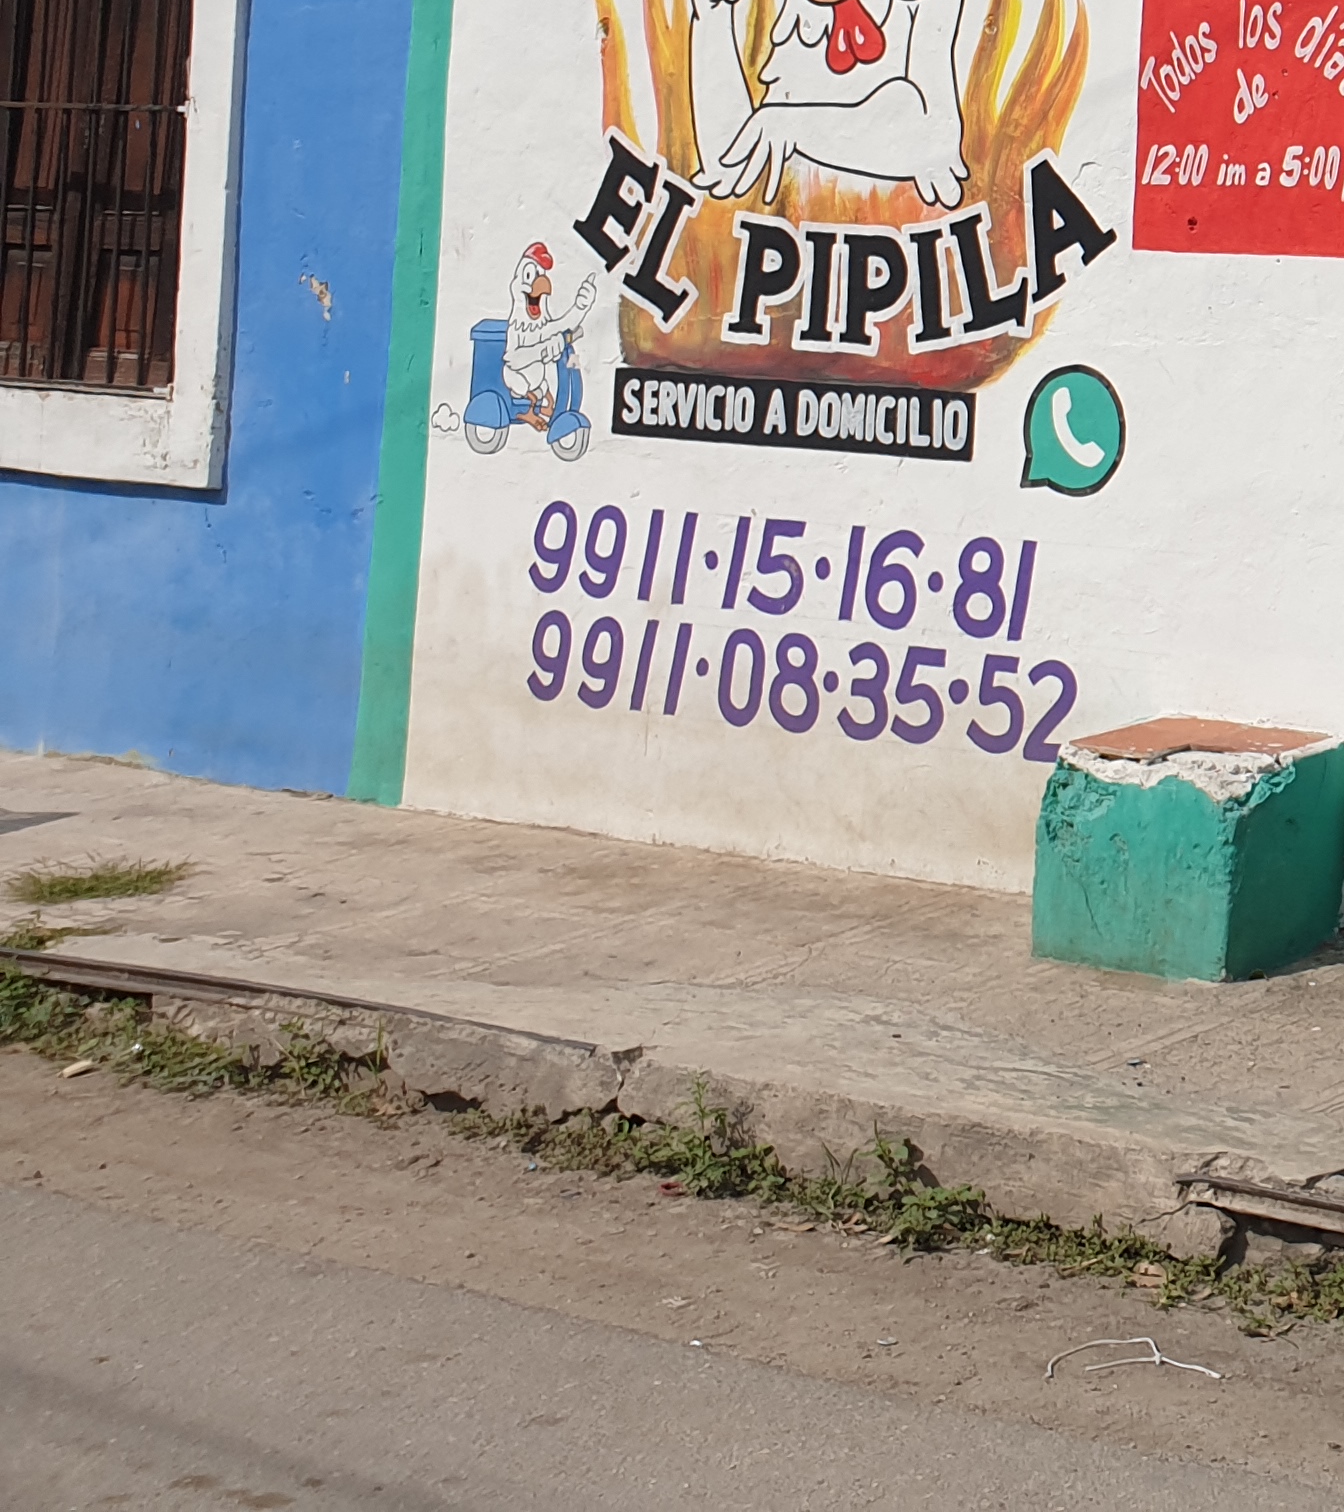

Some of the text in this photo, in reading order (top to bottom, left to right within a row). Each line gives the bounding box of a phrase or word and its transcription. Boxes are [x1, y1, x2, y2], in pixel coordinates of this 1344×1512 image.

[1140, 21, 1218, 114] Todos
[1233, 68, 1269, 124] de
[1141, 143, 1209, 187] 12:00
[1255, 162, 1271, 186] a
[1279, 145, 1340, 191] 5:00
[573, 135, 1117, 347] EL PIPILA
[622, 382, 970, 451] SERVICIO A DOMICILIO
